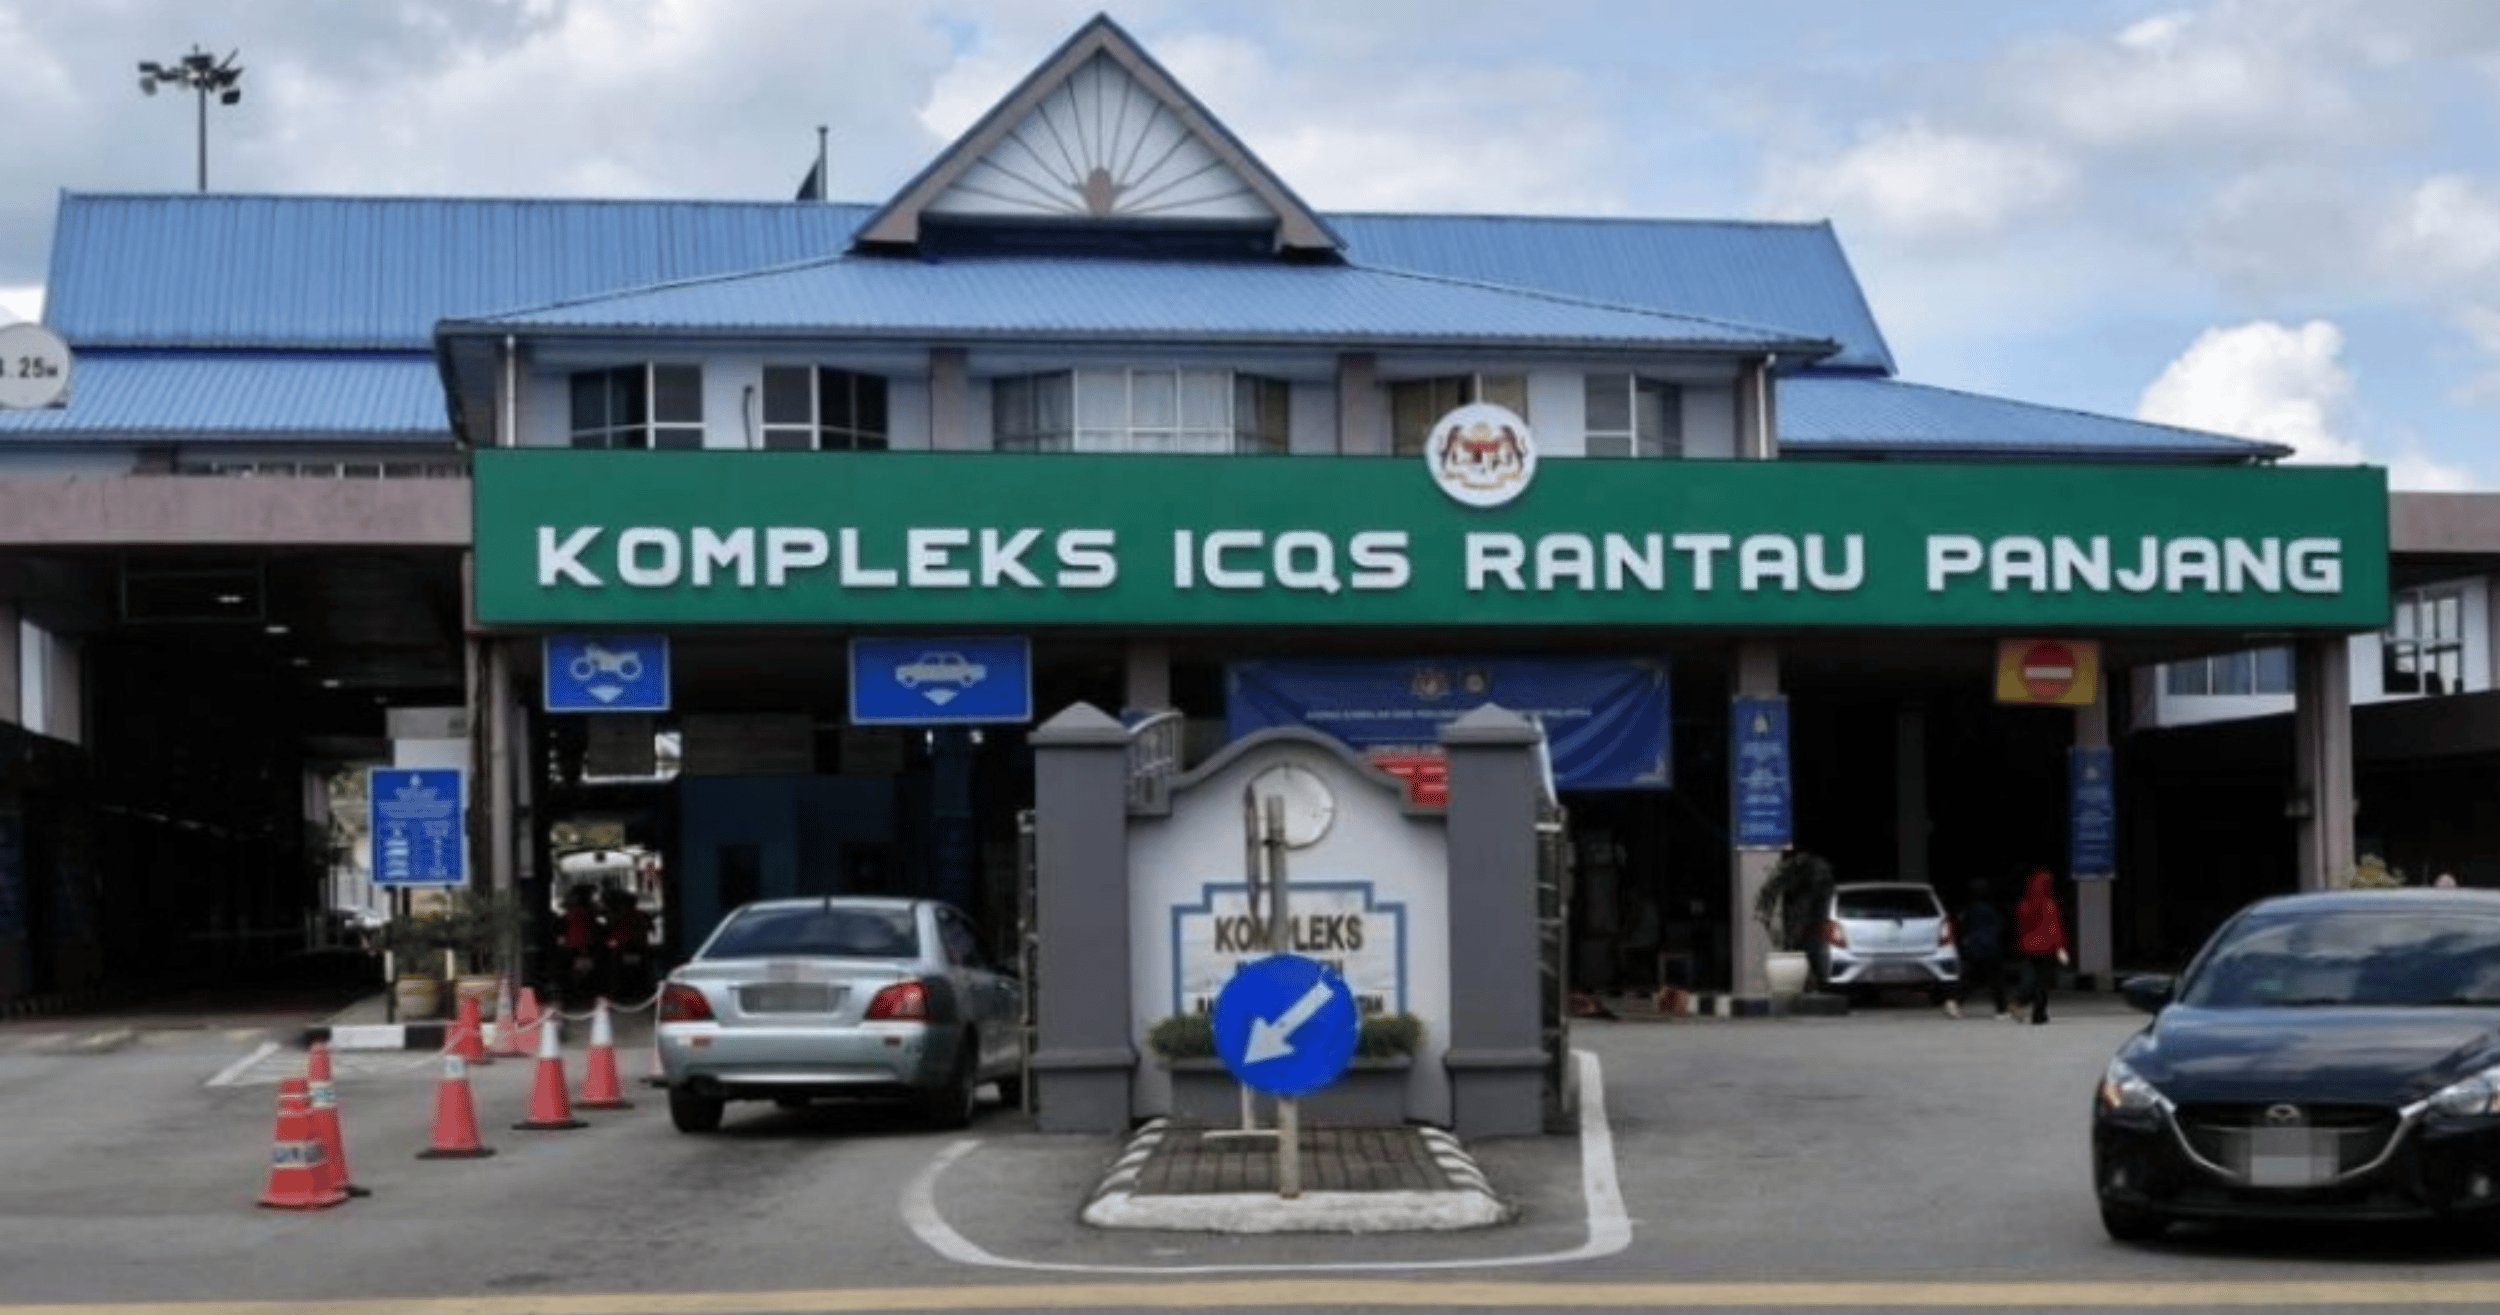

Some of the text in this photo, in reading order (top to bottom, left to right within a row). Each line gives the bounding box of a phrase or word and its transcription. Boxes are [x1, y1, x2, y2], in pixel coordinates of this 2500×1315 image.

[538, 526, 2342, 594] KOMPLEKS ICQS RANTAU PANJANG
